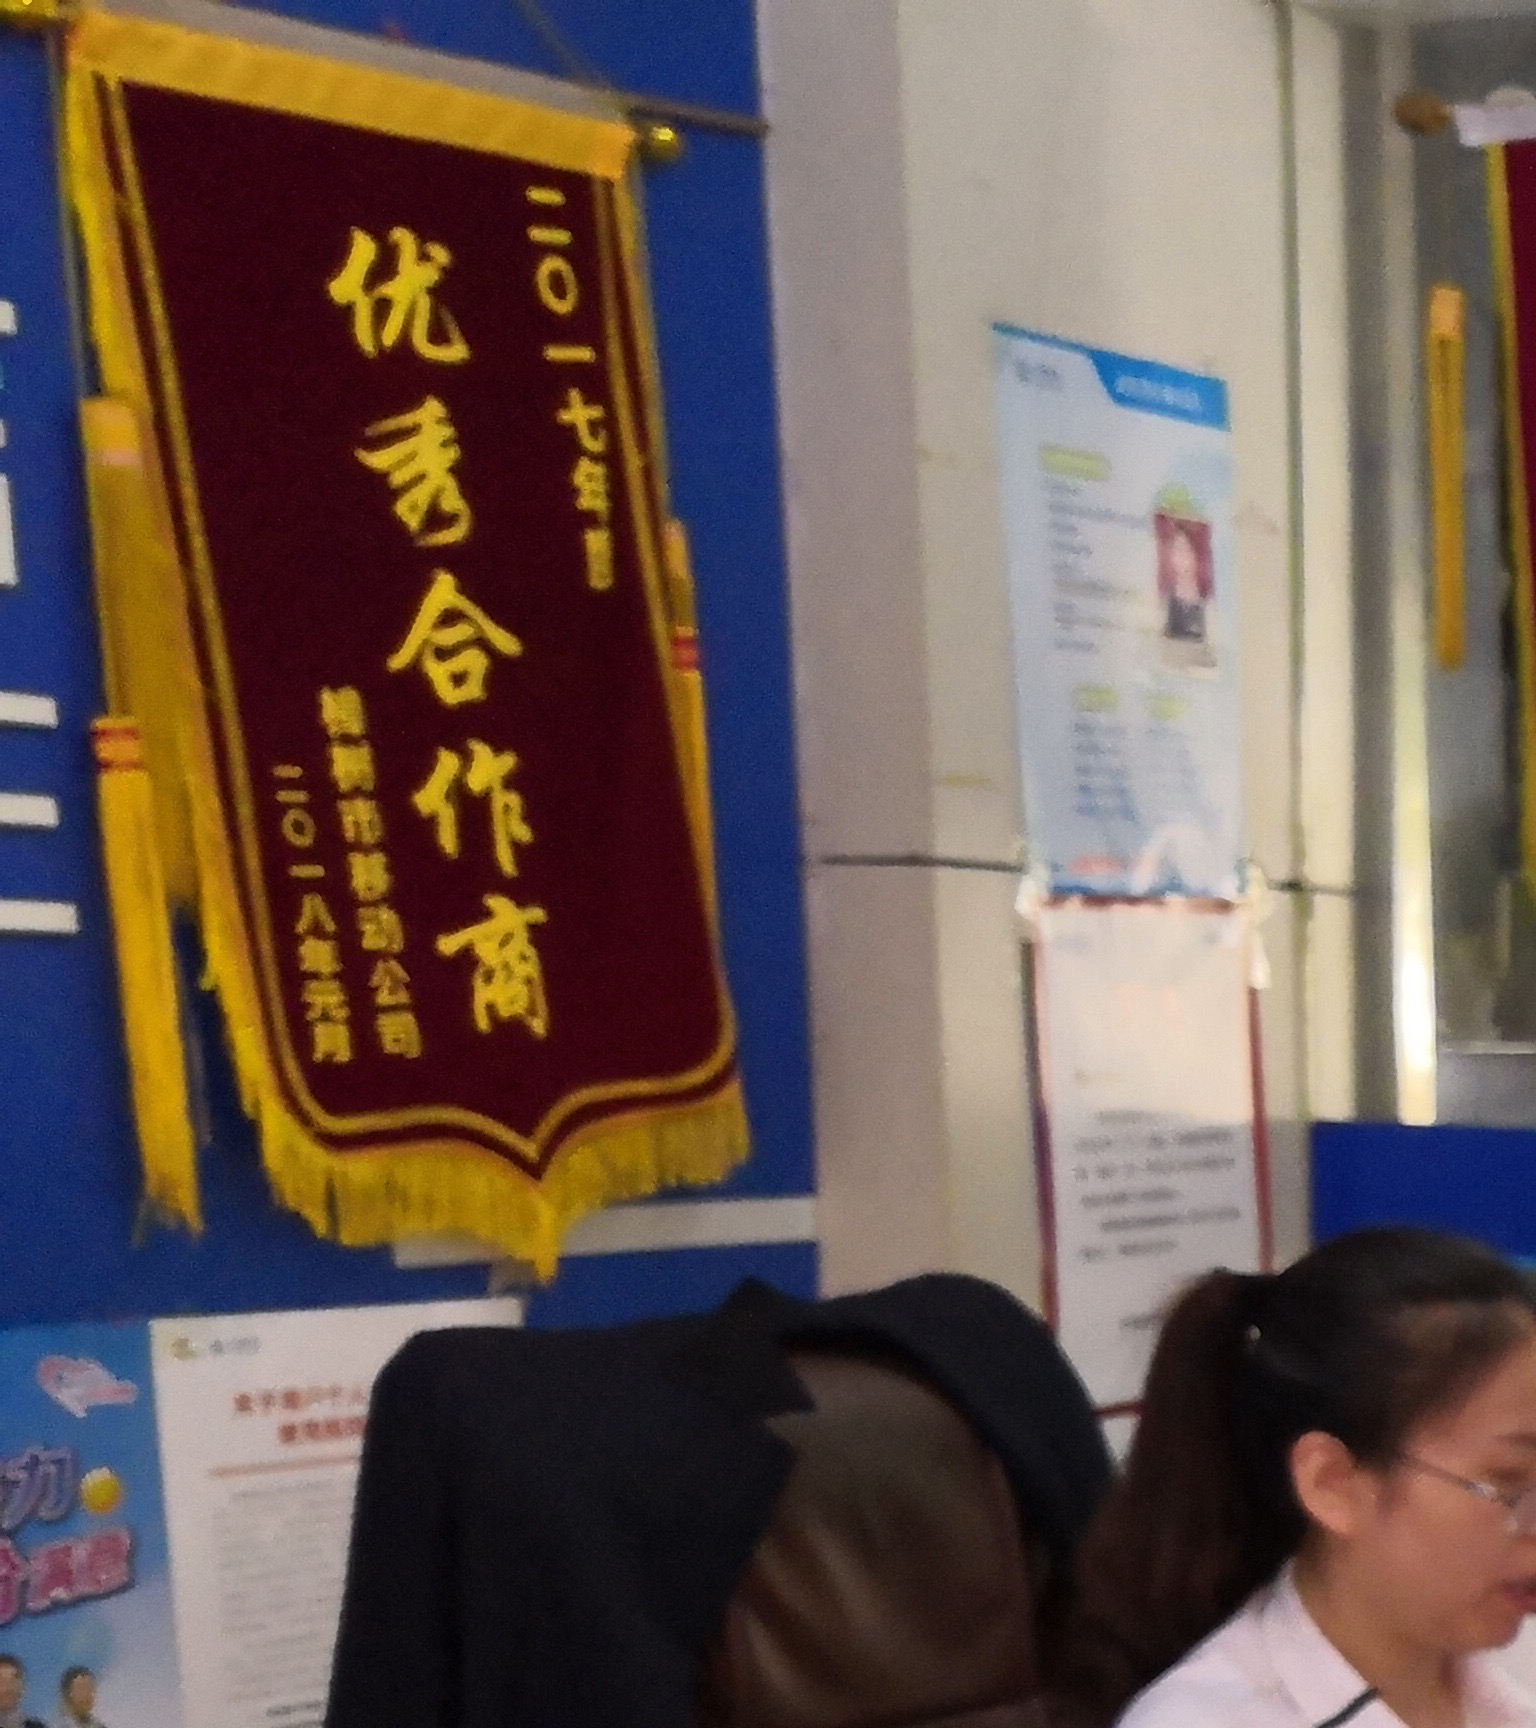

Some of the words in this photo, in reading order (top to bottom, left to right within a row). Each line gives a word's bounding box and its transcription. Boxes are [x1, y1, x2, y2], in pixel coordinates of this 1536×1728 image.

[326, 227, 550, 1041] 优秀合作商
